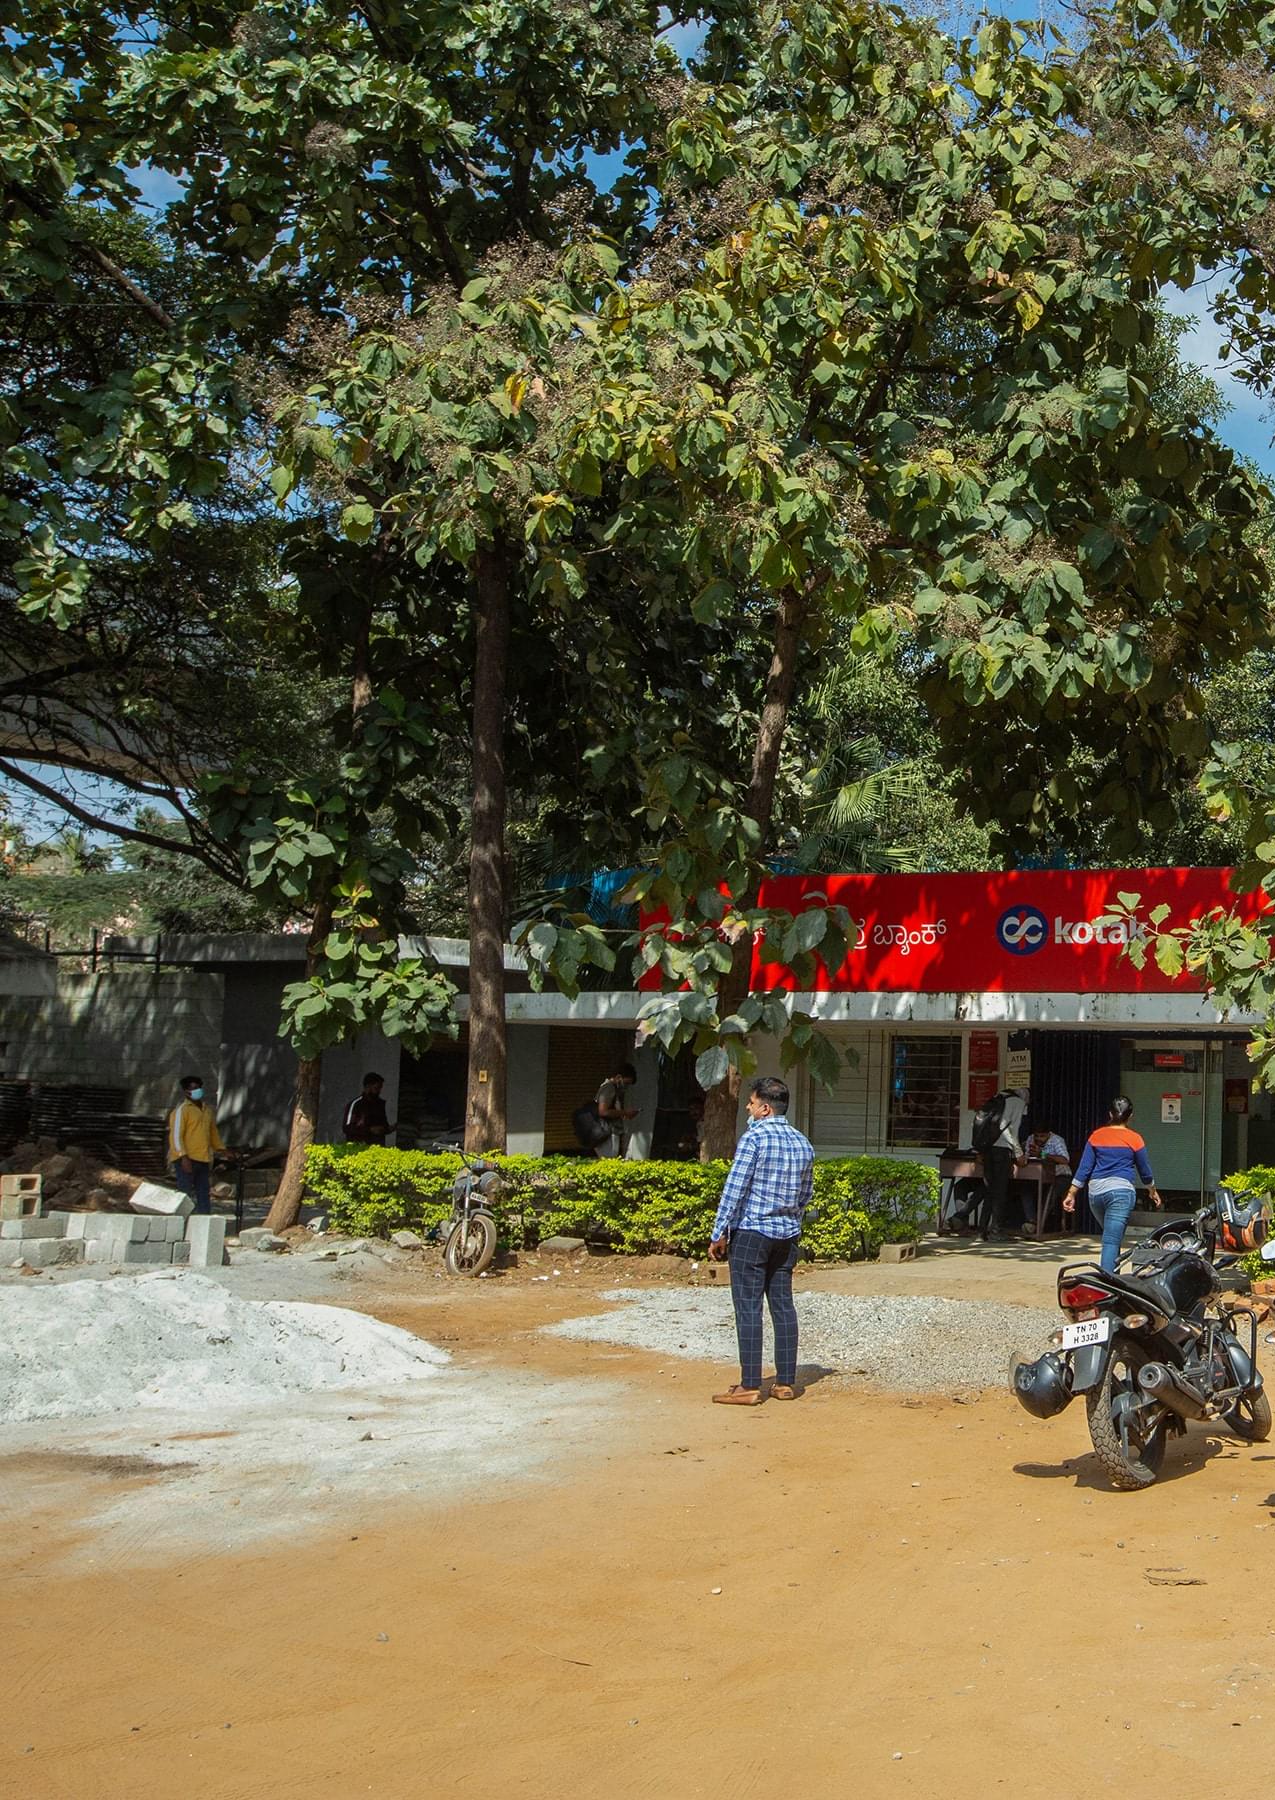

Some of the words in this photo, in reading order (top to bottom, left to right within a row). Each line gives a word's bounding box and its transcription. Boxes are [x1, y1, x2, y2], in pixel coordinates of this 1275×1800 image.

[874, 919, 947, 955] ಬ್ಯಾಂಕ್
[1054, 916, 1148, 944] kotak
[1076, 1325, 1086, 1333] TN
[1089, 1323, 1097, 1331] 70
[1081, 1333, 1099, 1343] 3328
